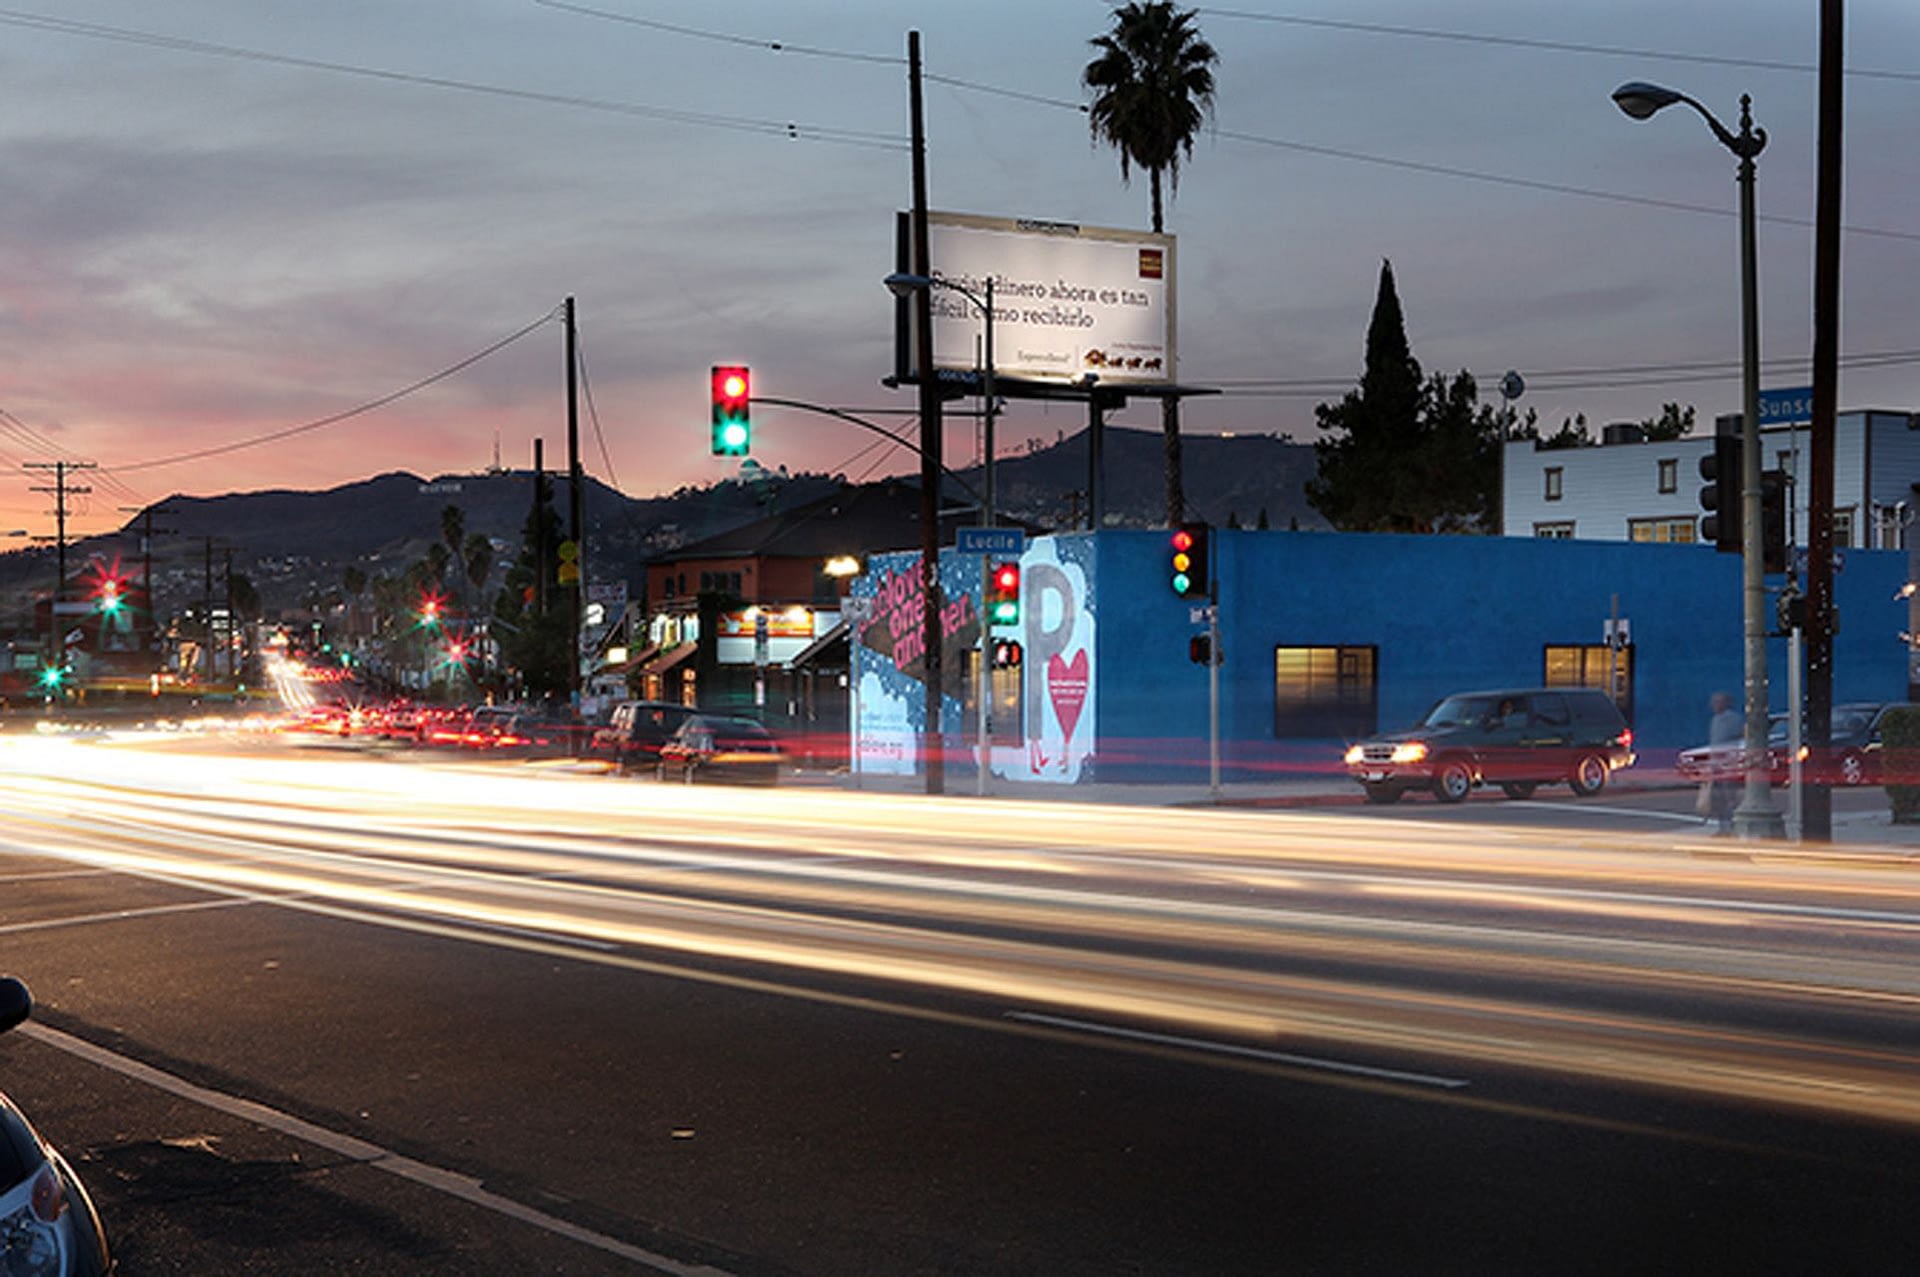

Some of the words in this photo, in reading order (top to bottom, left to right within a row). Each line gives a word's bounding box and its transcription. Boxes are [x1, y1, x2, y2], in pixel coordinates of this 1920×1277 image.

[993, 275, 1048, 299] dinero
[1049, 279, 1097, 302] ahora
[1099, 288, 1119, 305] es
[1121, 289, 1150, 307] tan
[971, 307, 1019, 323] cmo
[1023, 306, 1095, 328] recibirlo
[965, 534, 1016, 549] Lucile
[888, 592, 927, 640] one
